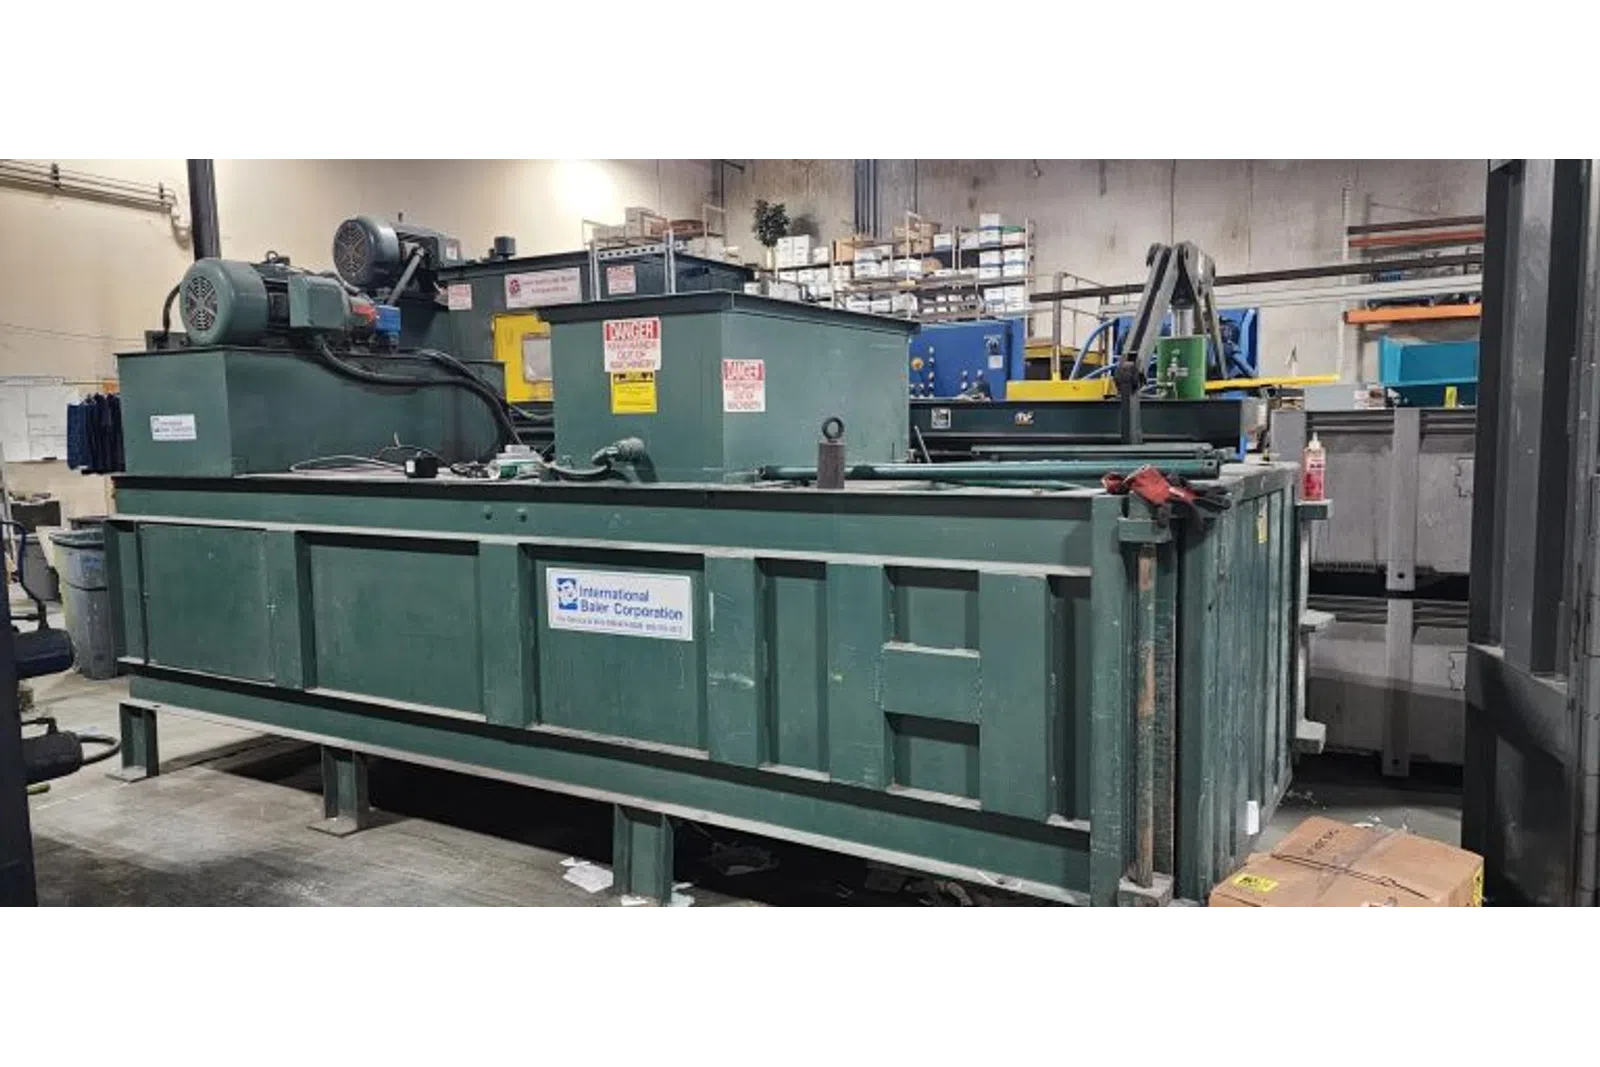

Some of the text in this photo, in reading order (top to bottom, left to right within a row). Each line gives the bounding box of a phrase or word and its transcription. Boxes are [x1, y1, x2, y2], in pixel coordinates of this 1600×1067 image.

[609, 321, 654, 341] DANGER
[580, 585, 649, 602] International
[614, 602, 683, 620] Corporation
